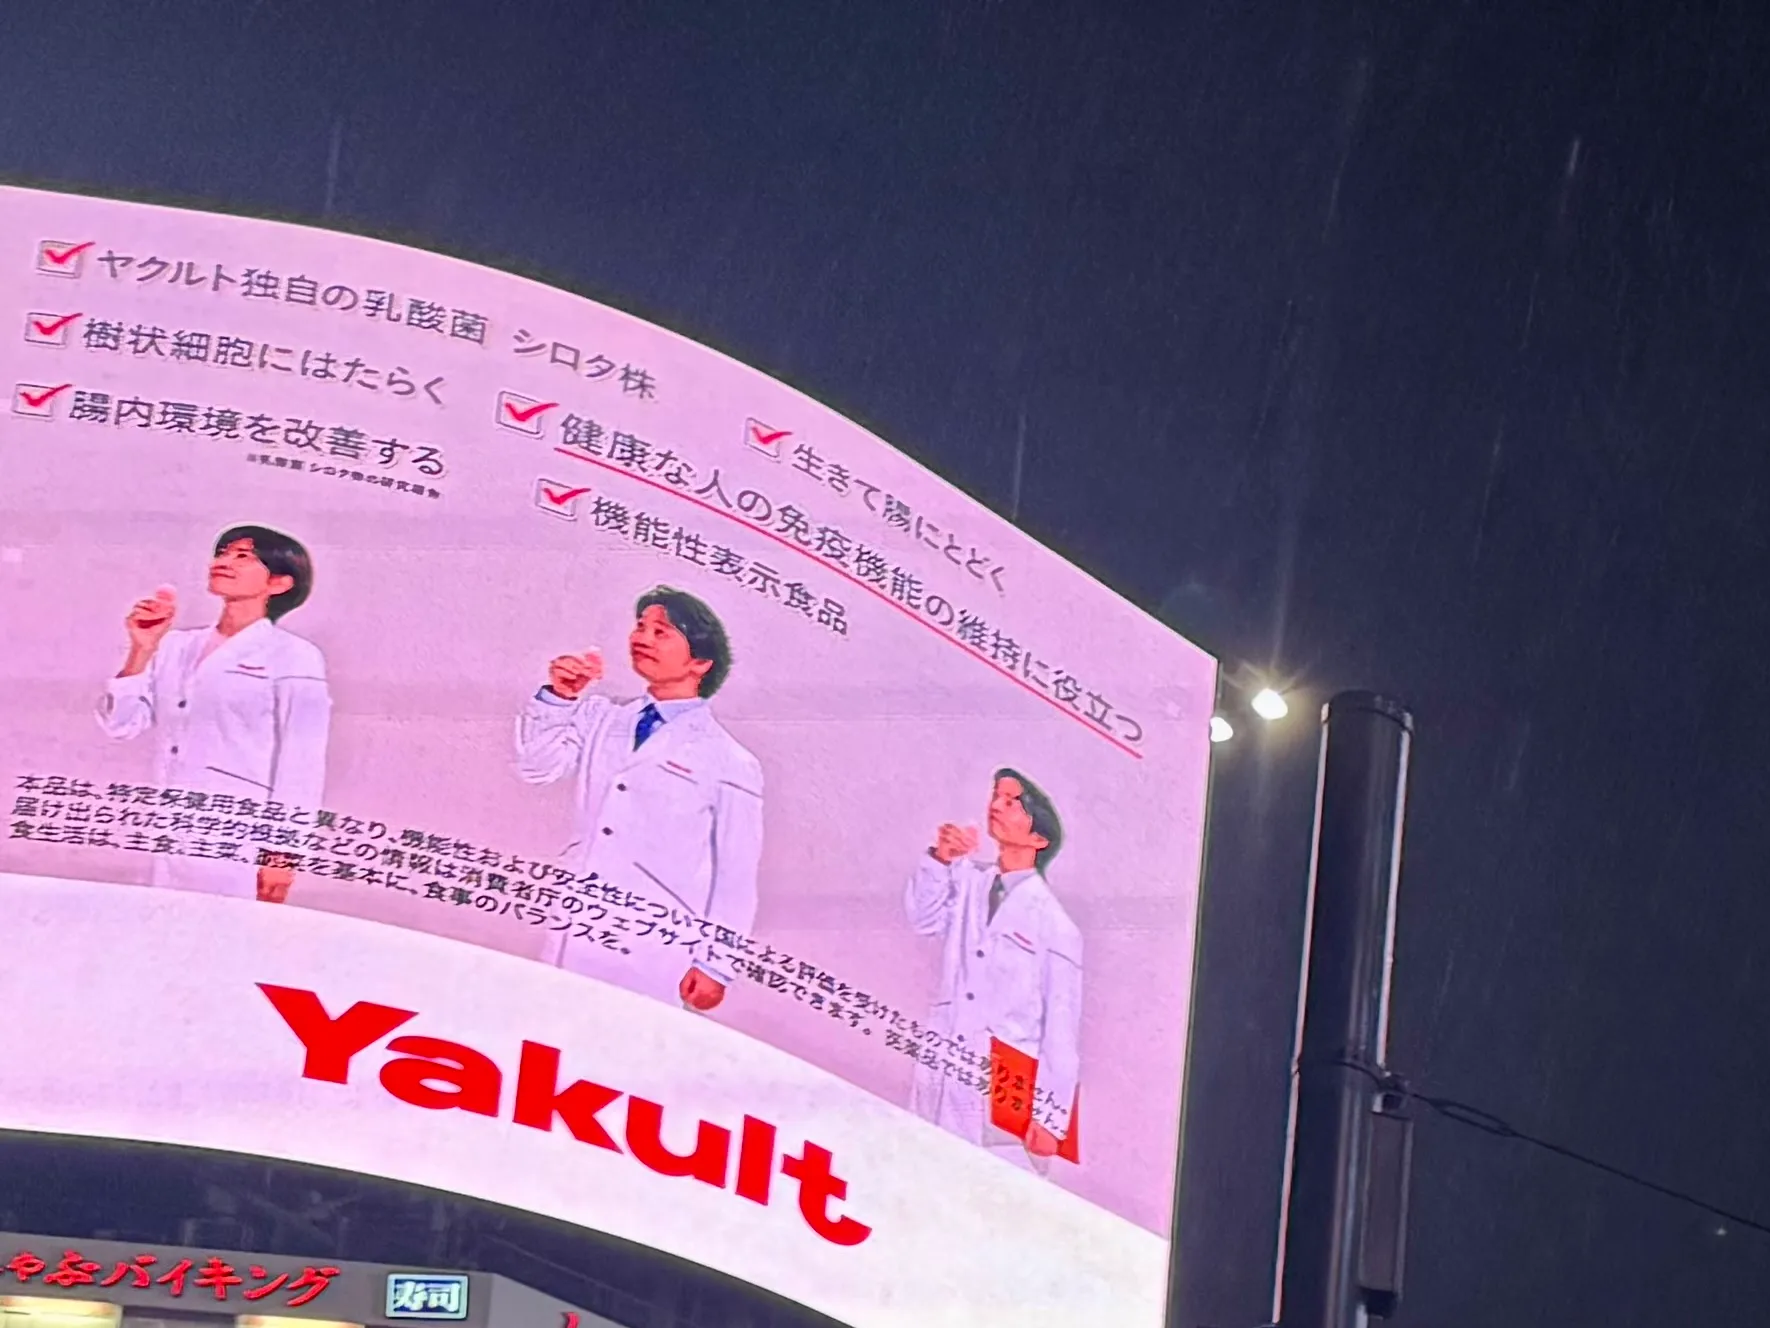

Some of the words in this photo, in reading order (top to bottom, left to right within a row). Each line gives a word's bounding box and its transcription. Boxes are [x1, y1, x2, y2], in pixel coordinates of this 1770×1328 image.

[81, 318, 448, 406] 樹状細胞にはたらく
[97, 248, 487, 347] ヤクルト独自の乳酸菌
[512, 327, 658, 400] シロタ株
[68, 389, 446, 477] 腸内環境を改善する
[560, 412, 1145, 745] 健康な人の免疫機能の維持に役立つ
[590, 495, 849, 636] 機能性表示食品
[791, 444, 1007, 596] 生きて腸にとどく
[253, 981, 872, 1247] Yakult
[0, 1249, 340, 1307] ゃぶバイキング
[393, 1280, 461, 1313] 寿司
